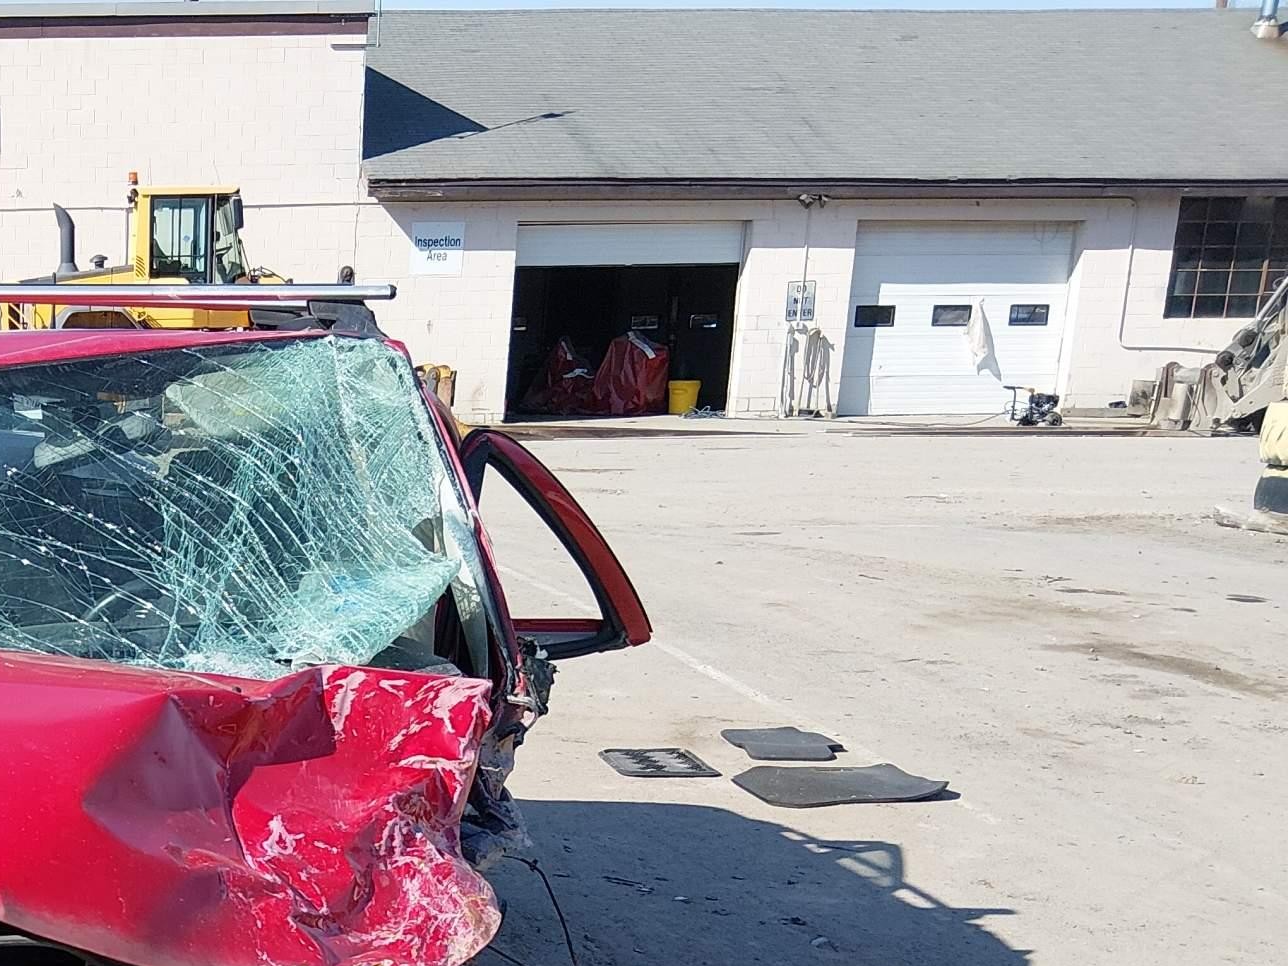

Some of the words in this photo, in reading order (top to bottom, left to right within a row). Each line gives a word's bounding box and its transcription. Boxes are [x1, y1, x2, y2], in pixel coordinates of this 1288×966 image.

[415, 236, 461, 249] Inspection
[427, 250, 448, 261] Area
[793, 296, 808, 305] NT
[788, 308, 812, 317] ENER
